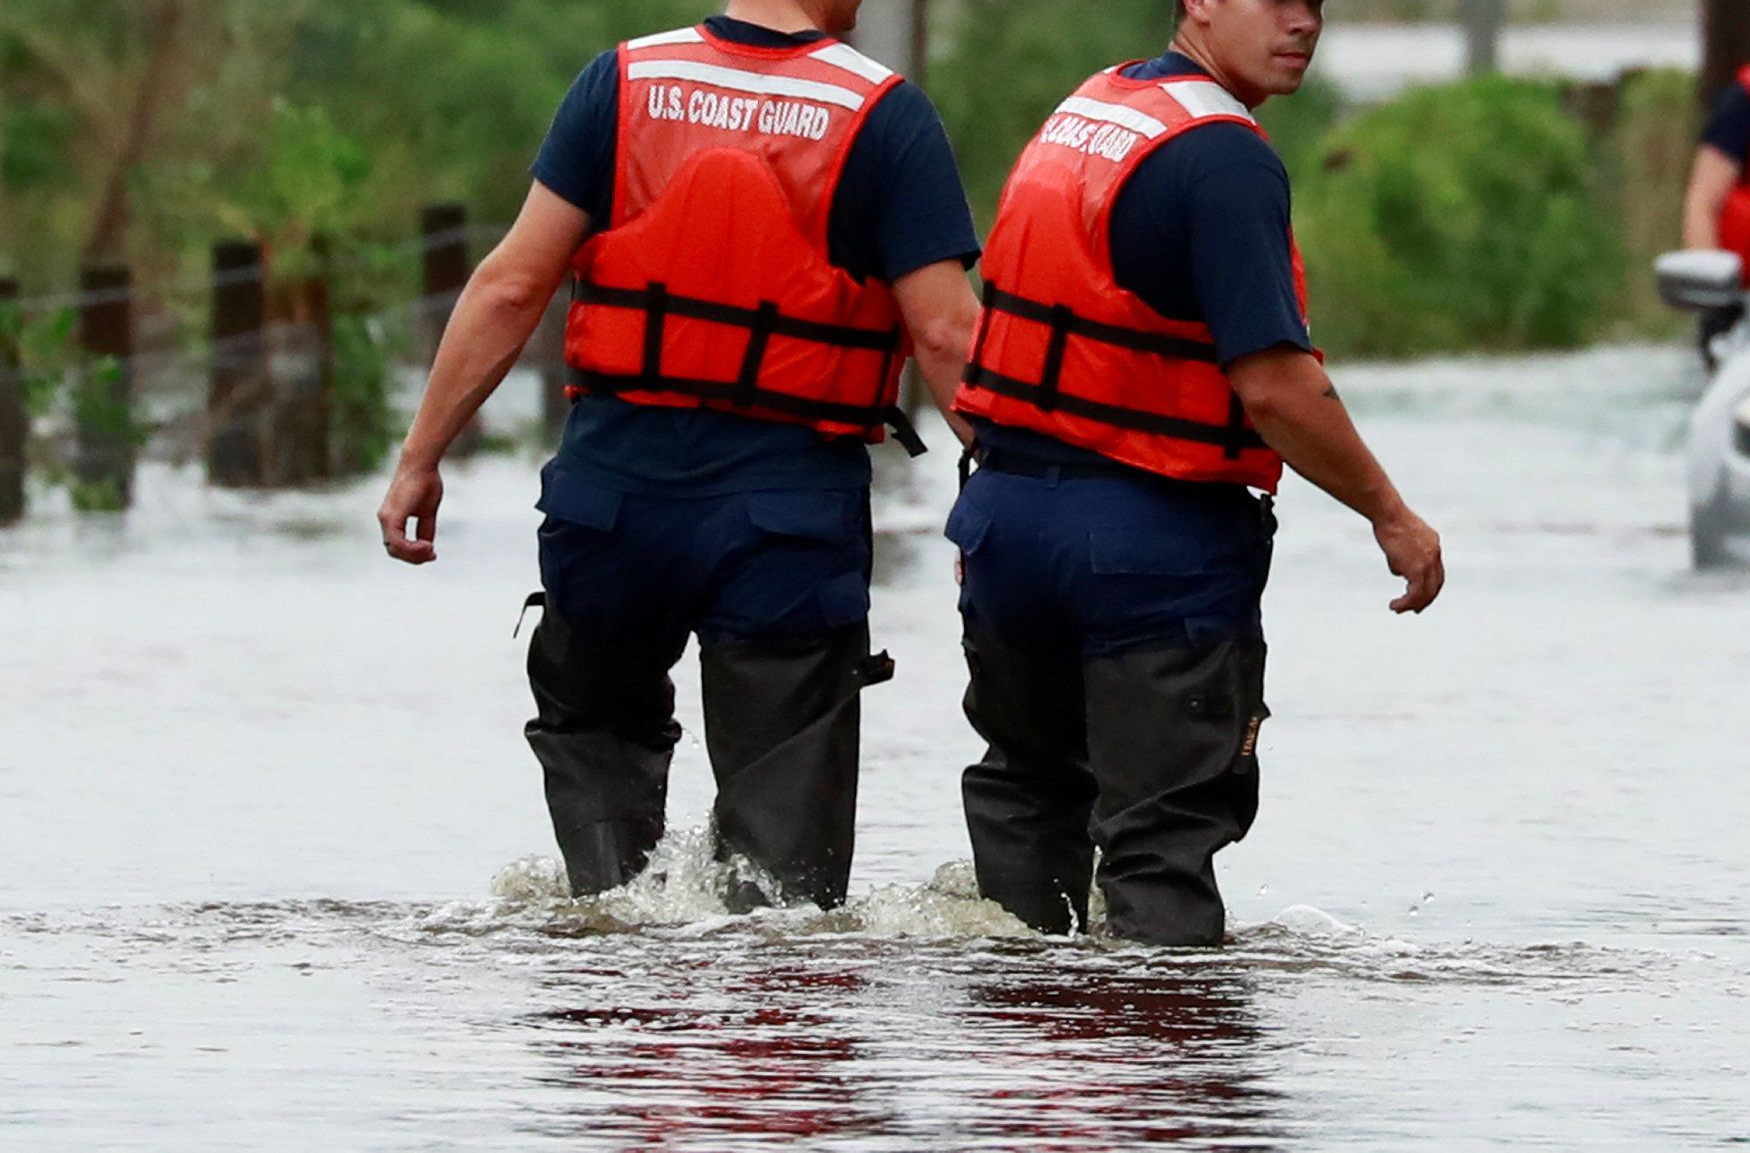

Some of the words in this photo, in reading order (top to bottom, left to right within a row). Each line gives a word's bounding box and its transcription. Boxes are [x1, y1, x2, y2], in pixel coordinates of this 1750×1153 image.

[649, 84, 685, 121] U.S.
[688, 89, 758, 131] COAST
[757, 100, 830, 141] GUARD
